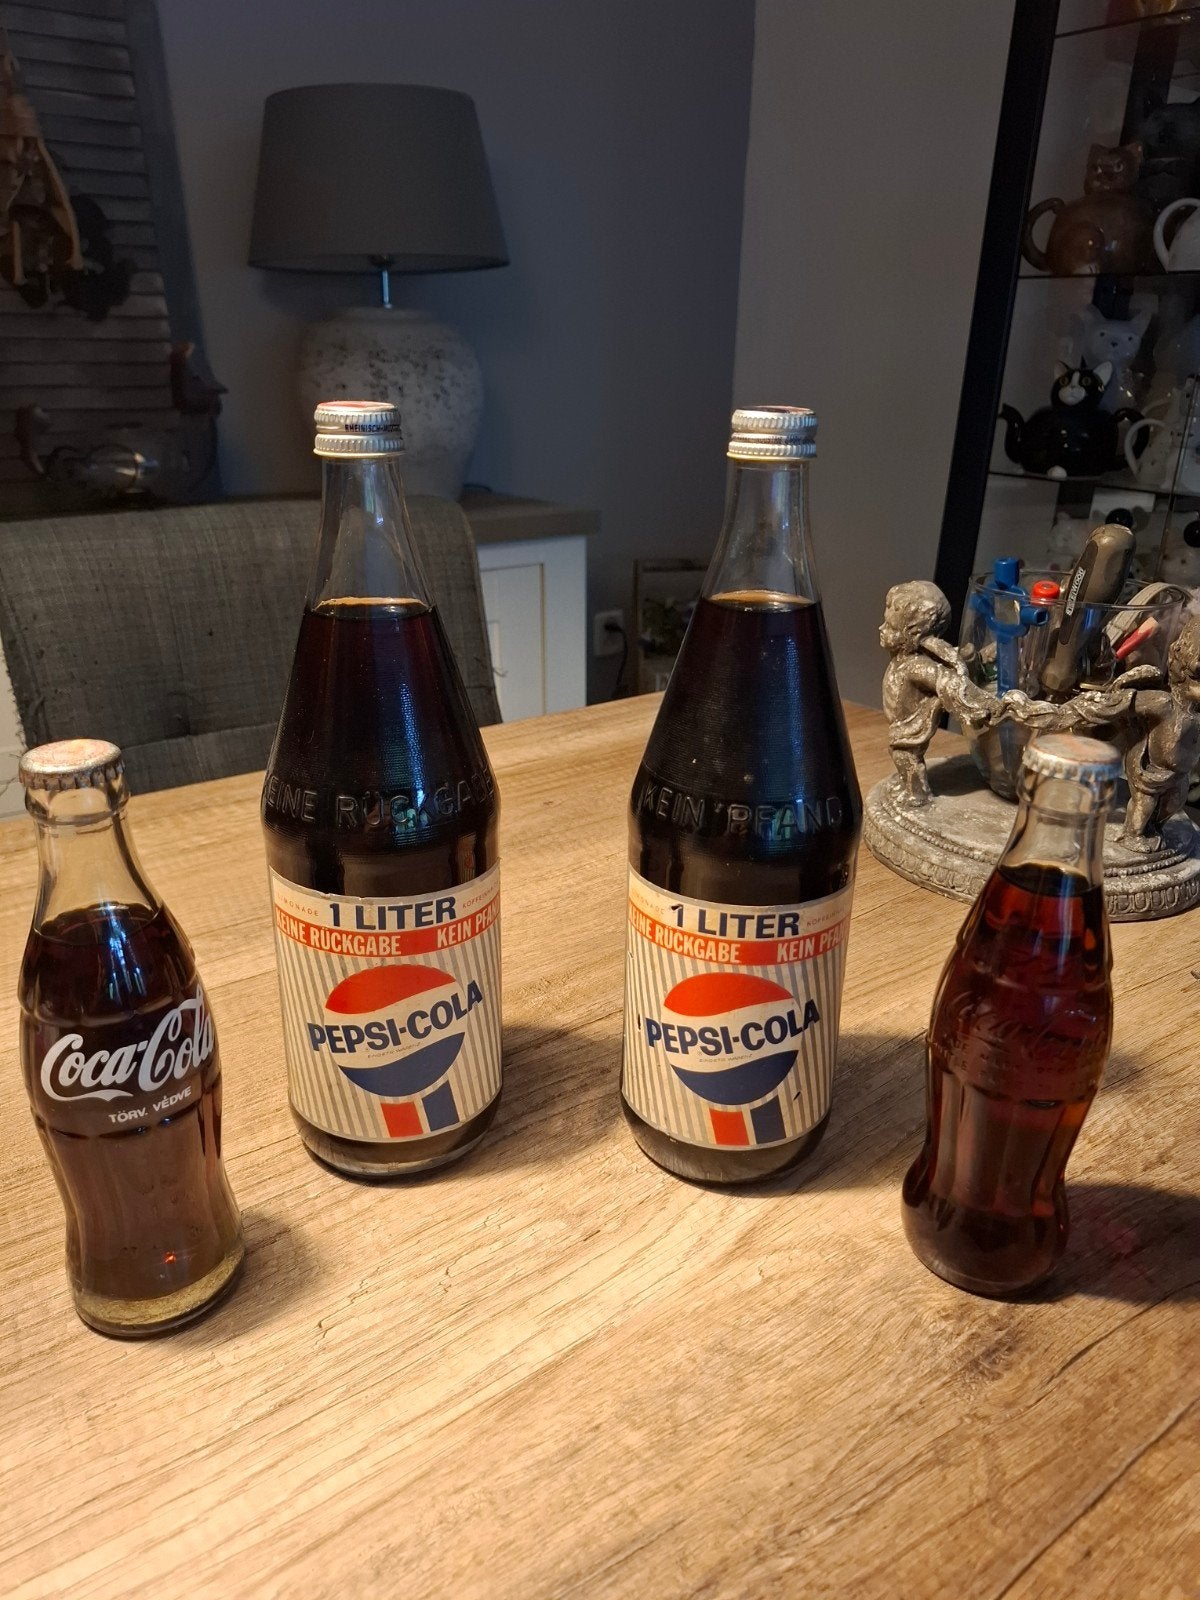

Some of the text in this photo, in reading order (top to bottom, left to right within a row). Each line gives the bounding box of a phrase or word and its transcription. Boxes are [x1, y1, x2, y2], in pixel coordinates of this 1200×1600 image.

[637, 782, 843, 836] KEIN PFAND
[329, 896, 457, 931] 1 LITER
[670, 903, 800, 939] 1 LITER
[310, 926, 401, 956] RÜCKGABE
[436, 921, 472, 949] KEIN
[655, 925, 741, 964] RÜCKGABE
[776, 936, 815, 964] KEIN
[307, 980, 483, 1055] PEPSI-COLA
[646, 998, 820, 1056] PEPSI-COLA
[40, 984, 215, 1102] Coca-Cola
[107, 1106, 149, 1125] TÖRV.
